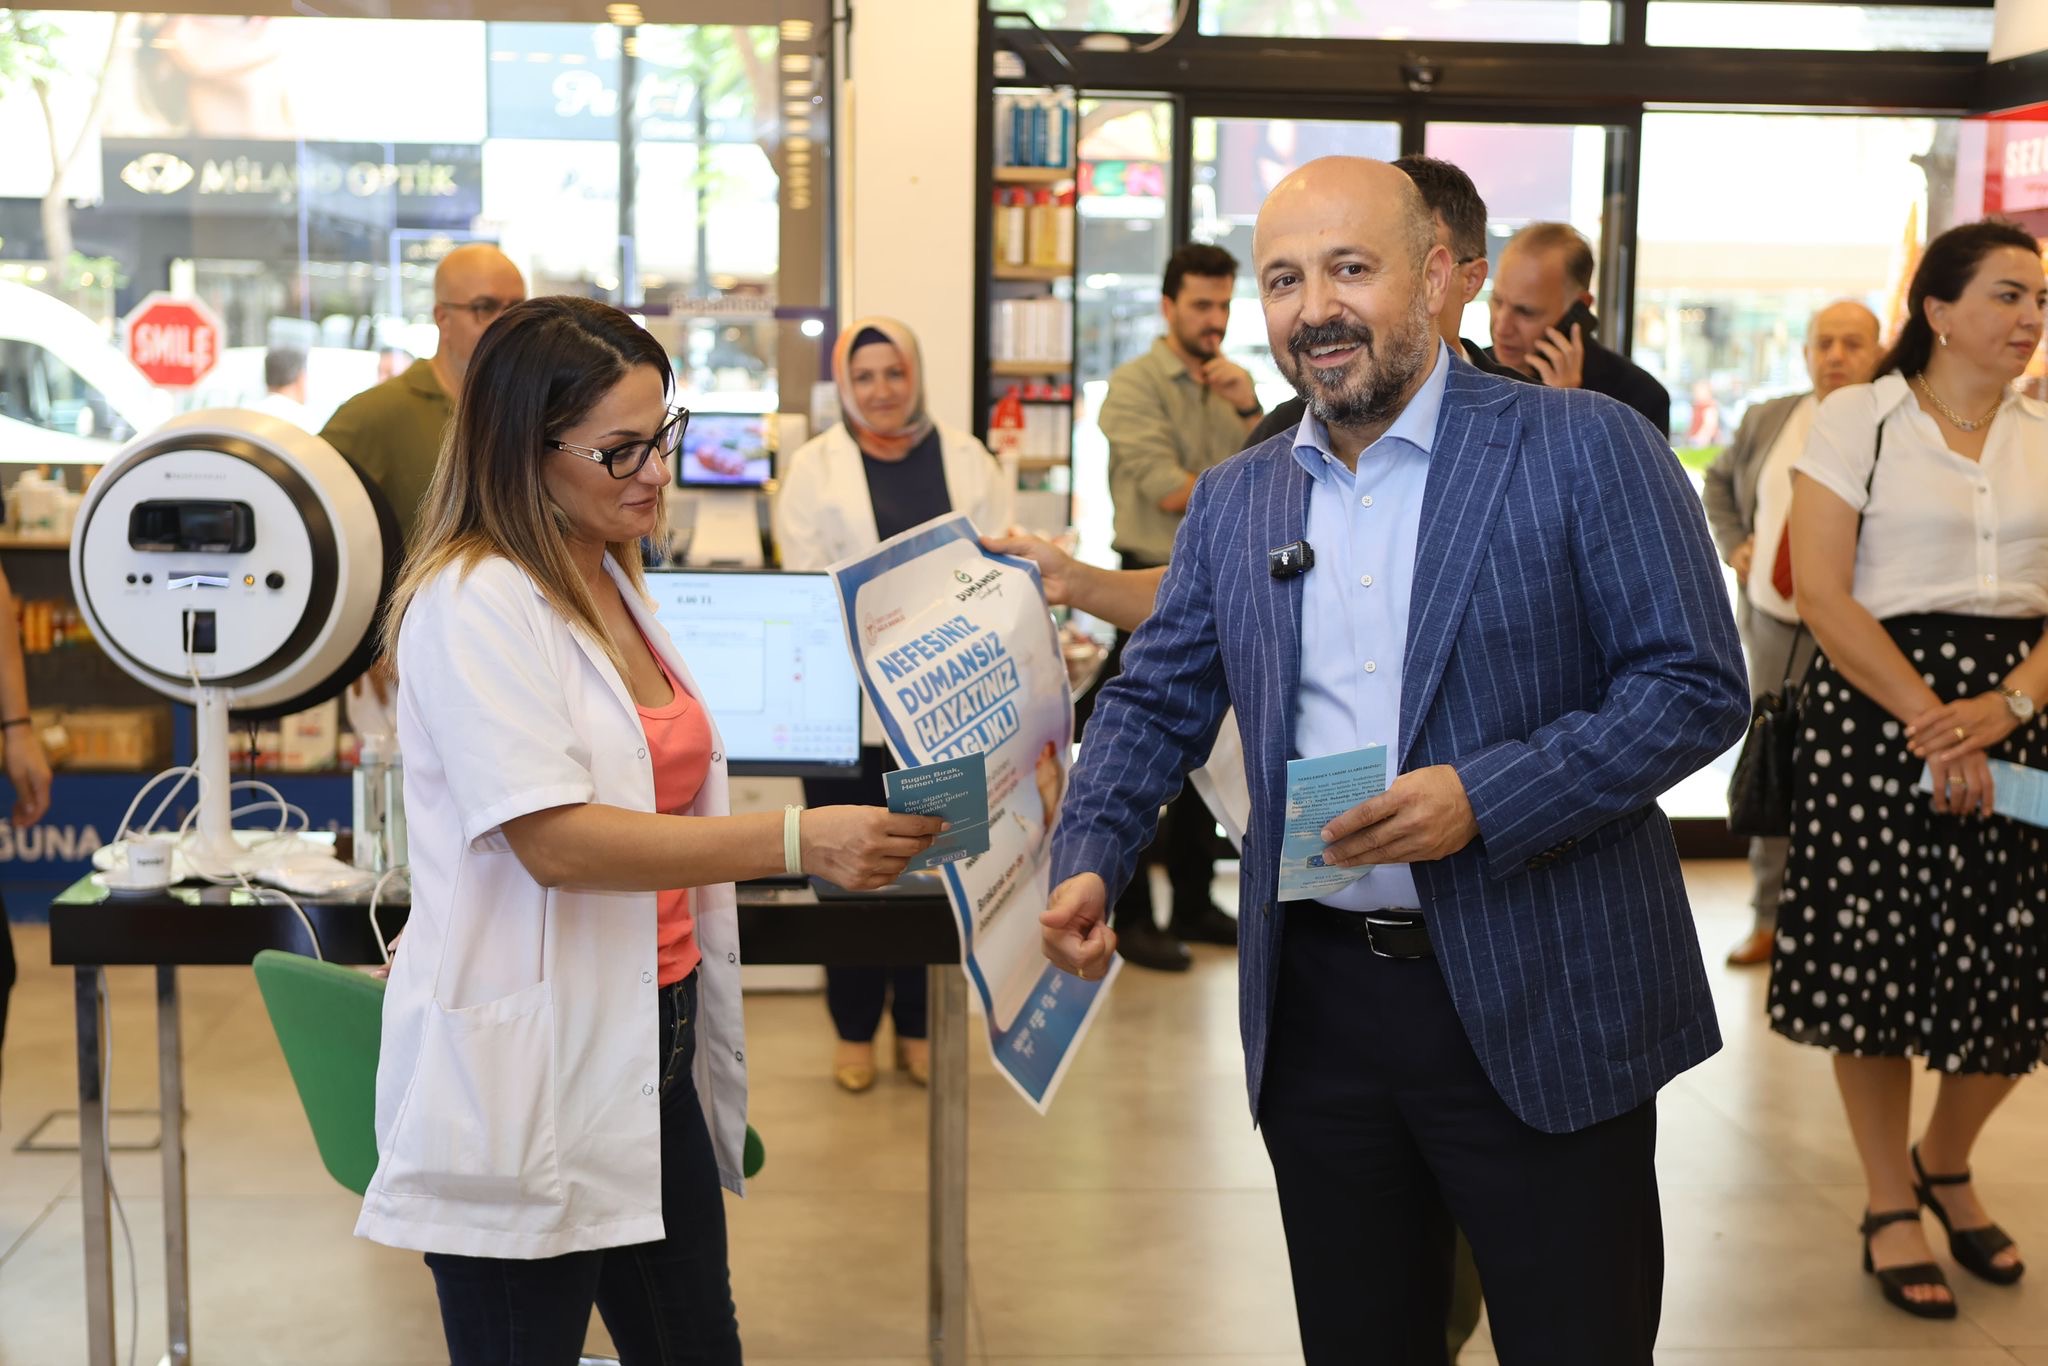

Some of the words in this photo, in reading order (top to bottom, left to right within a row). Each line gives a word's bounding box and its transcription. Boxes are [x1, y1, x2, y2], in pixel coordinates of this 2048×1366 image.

[135, 322, 213, 372] SMILE
[896, 631, 1006, 716] DUMANSIZ
[915, 659, 1017, 750] HAYATINIZ
[901, 774, 931, 785] Bugün
[901, 780, 934, 791] Hemen
[936, 772, 964, 783] Kazan
